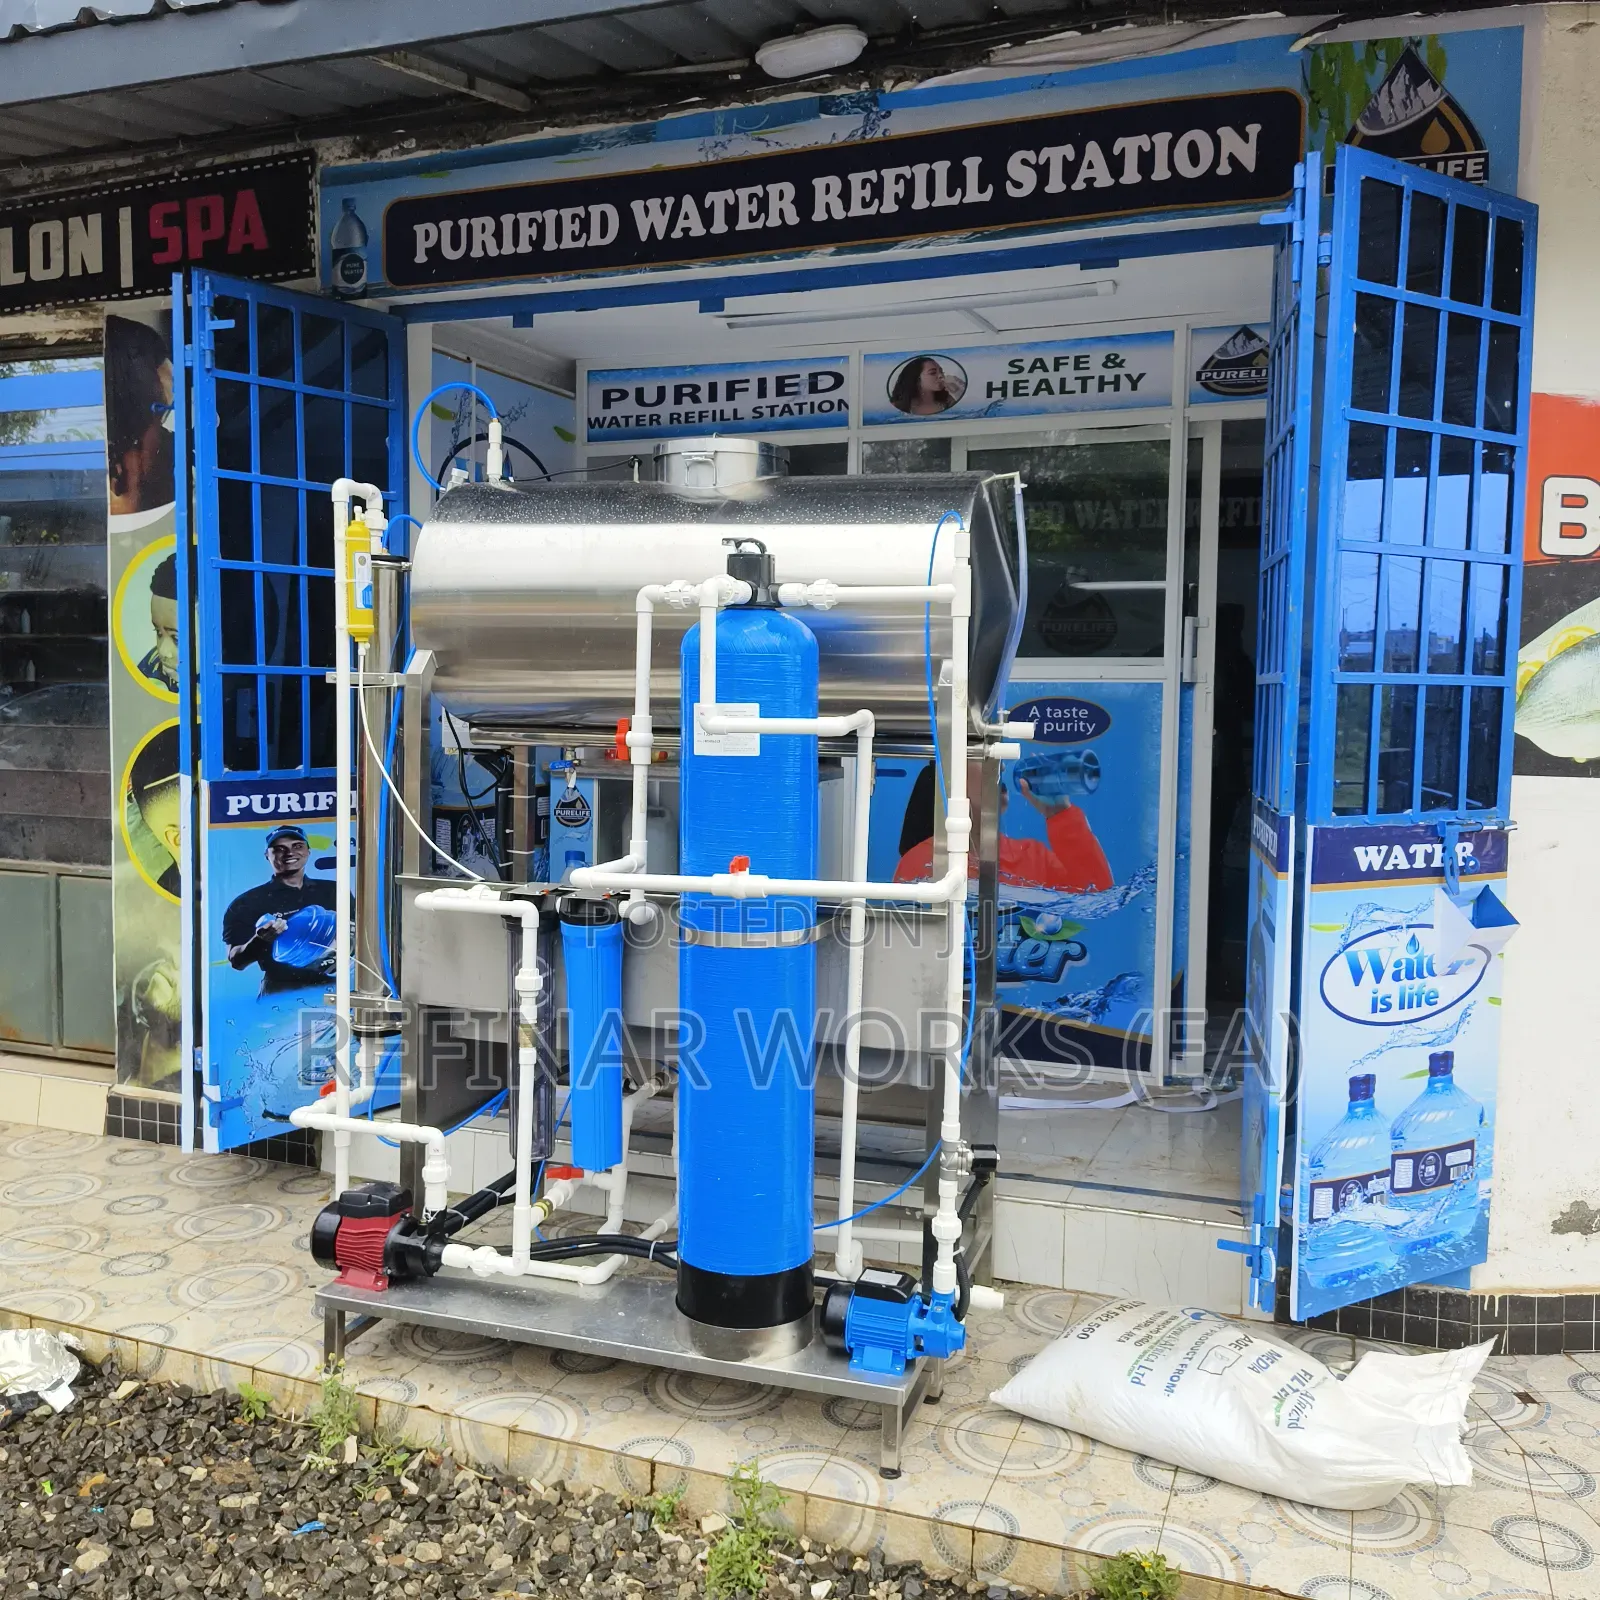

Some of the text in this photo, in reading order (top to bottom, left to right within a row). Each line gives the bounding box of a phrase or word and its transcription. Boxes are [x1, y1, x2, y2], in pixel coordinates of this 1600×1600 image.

[413, 123, 1262, 264] PURIFIED WATER REFILL STATION
[0, 213, 104, 286] LON
[149, 189, 269, 265] SPA
[1007, 353, 1126, 375] SAFE &
[1200, 368, 1267, 381] PURELI
[602, 370, 845, 410] PURIFIED
[986, 372, 1147, 399] HEALTHY
[587, 398, 849, 429] WATER REFILL STATION
[1540, 475, 1600, 558] B
[1028, 706, 1089, 718] A taste
[1043, 720, 1096, 735] purity
[226, 790, 337, 816] PURIF
[555, 809, 591, 817] PURELIFE
[1371, 982, 1440, 1014] is life
[1095, 1311, 1119, 1322] 582
[1077, 1323, 1100, 1339] 560
[1116, 1328, 1136, 1344] AREA
[1228, 1333, 1253, 1351] ADE
[1182, 1330, 1217, 1361] PRODUCT
[1247, 1349, 1282, 1374] MEDIA
[1163, 1364, 1187, 1397] FROM:
